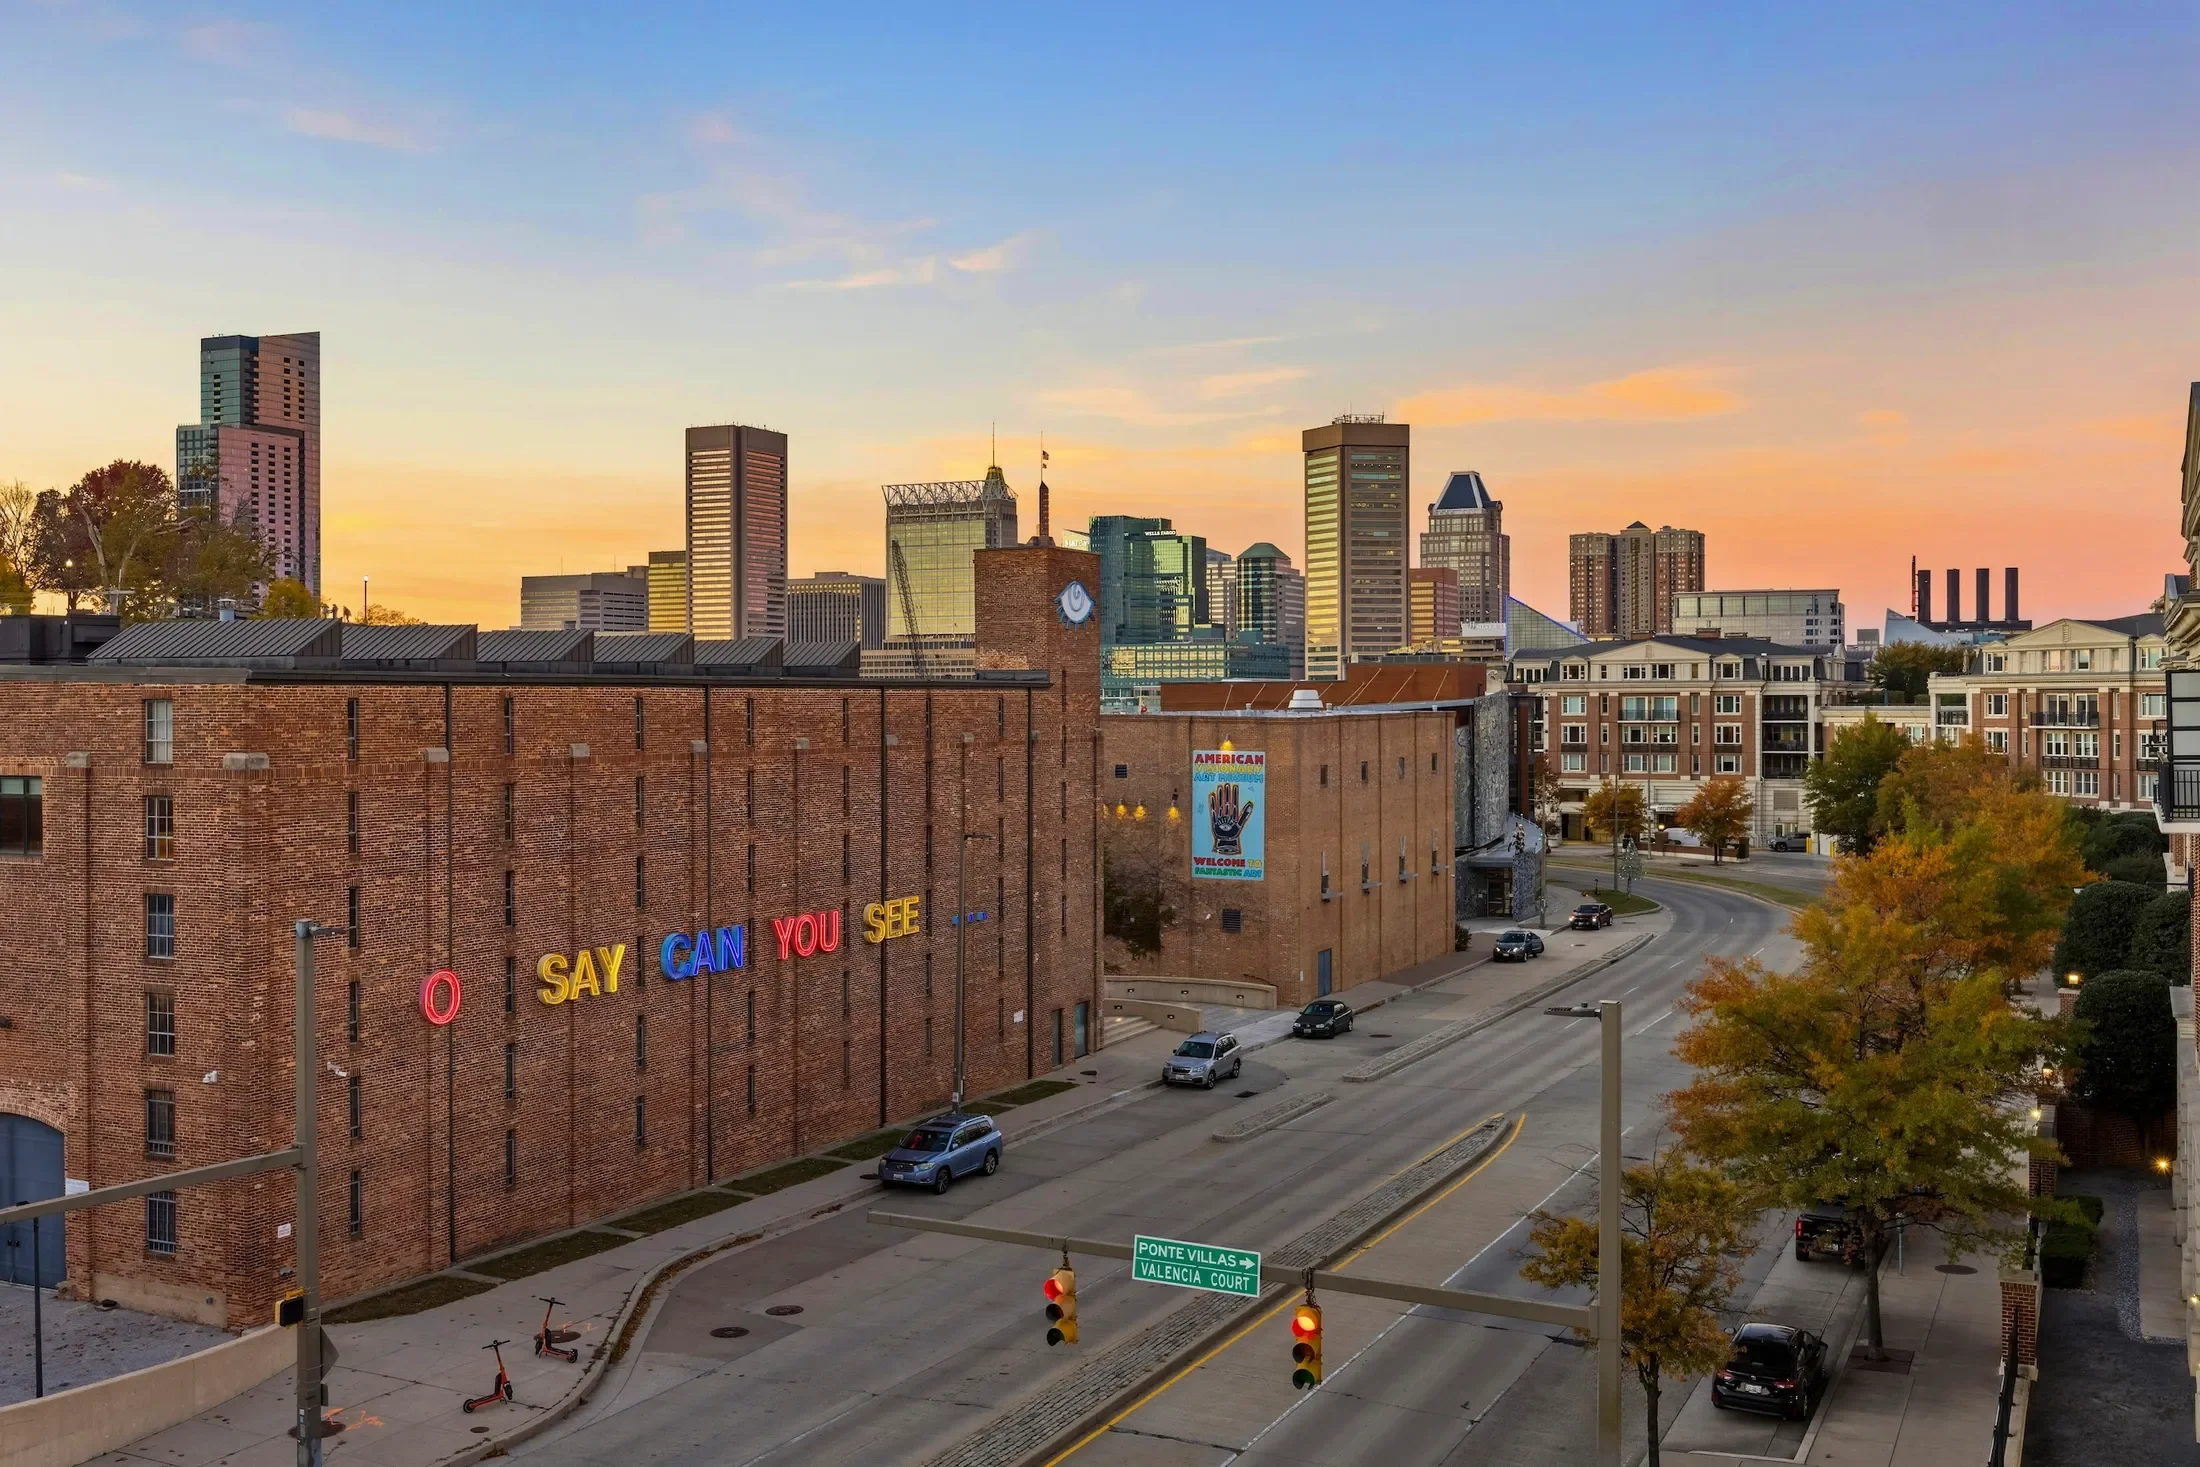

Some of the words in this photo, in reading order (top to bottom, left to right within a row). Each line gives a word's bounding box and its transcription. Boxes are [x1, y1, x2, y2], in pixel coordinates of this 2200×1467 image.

[1194, 753, 1264, 765] AMERICAN
[1195, 763, 1263, 774] VISIONARY
[1194, 772, 1216, 782] ART
[1218, 773, 1264, 783] MUSEUM
[1193, 856, 1246, 868] WELCOME
[1247, 859, 1262, 869] TO
[1194, 866, 1243, 877] FANTASTIC
[420, 968, 462, 1026] O
[536, 943, 626, 1005] SAY
[660, 924, 745, 981] CAN
[770, 909, 840, 960] YOU
[863, 895, 920, 944] SEE
[1139, 1241, 1185, 1260] PONTE
[1187, 1248, 1237, 1268] VILLAS
[1140, 1261, 1201, 1284] VALENCIA
[1210, 1272, 1250, 1291] COURT
